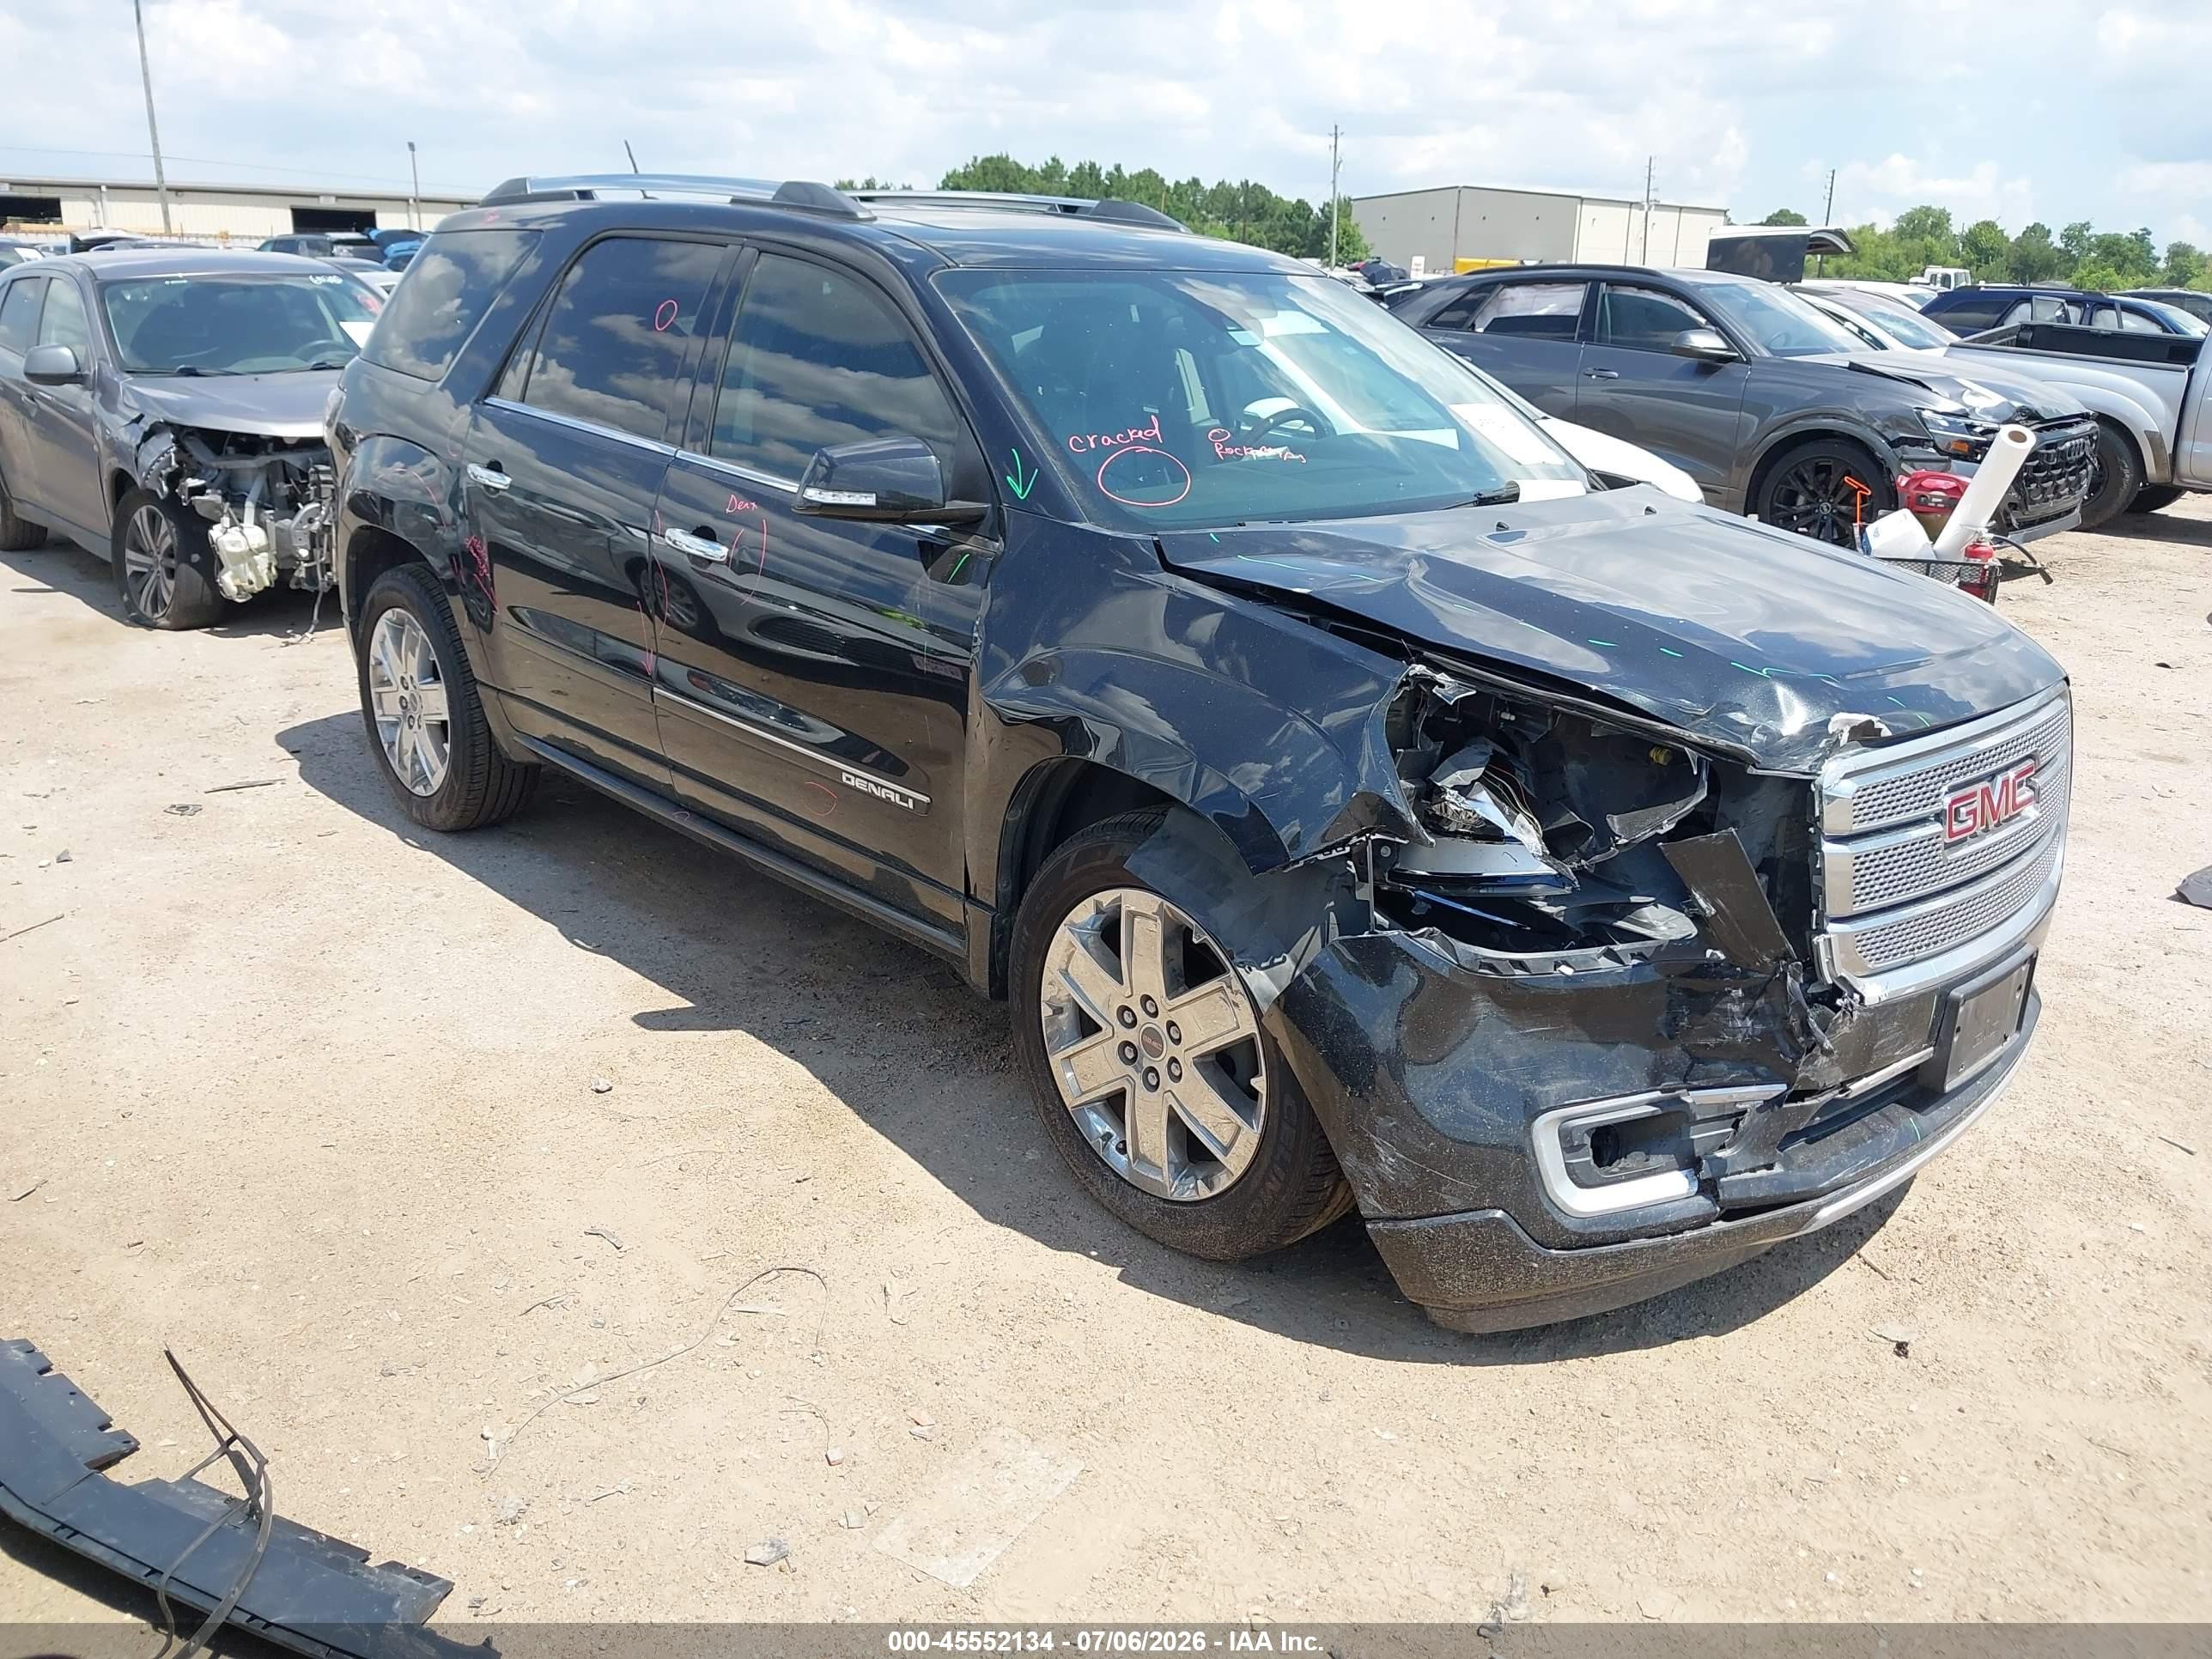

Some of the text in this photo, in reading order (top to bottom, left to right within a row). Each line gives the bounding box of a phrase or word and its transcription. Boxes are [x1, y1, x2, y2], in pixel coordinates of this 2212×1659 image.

[1068, 414, 1164, 453] cracked
[842, 771, 914, 810] DENALI
[1943, 760, 2036, 843] GMC
